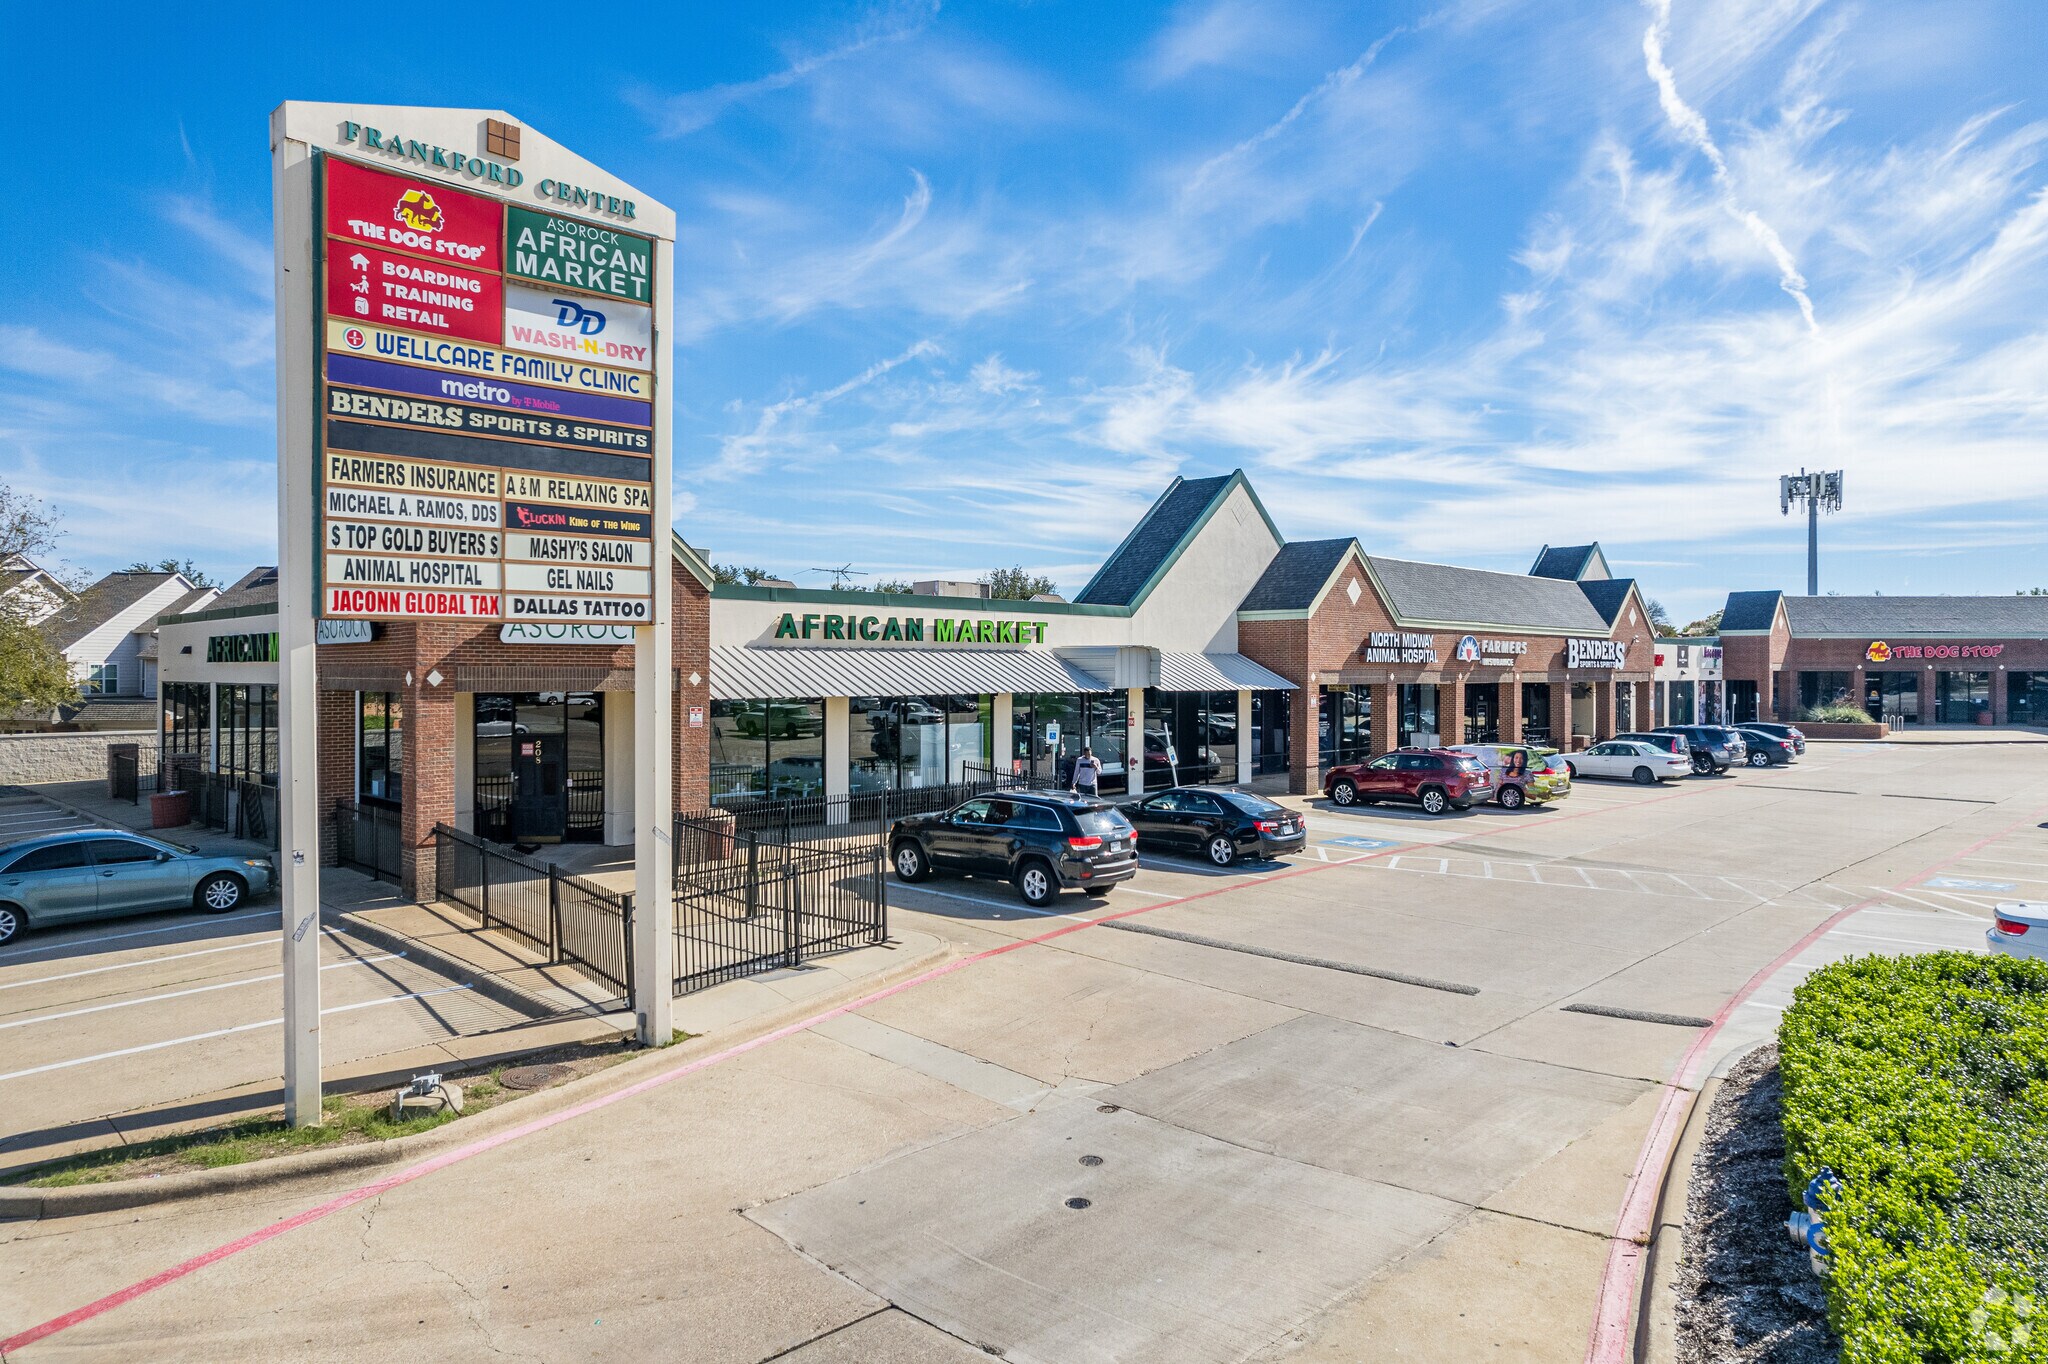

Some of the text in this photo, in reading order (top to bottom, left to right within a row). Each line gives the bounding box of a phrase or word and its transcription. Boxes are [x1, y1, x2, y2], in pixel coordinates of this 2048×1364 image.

[345, 120, 636, 219] FRANKFORD CENTER
[347, 220, 386, 240] THE
[389, 228, 432, 250] DOG
[546, 218, 619, 246] ASOROCK
[516, 227, 646, 276] AFRICAN
[382, 261, 481, 293] BOARDING
[516, 250, 646, 298] MARKET
[382, 282, 474, 312] TRAINING
[382, 304, 449, 328] RETAIL
[552, 298, 607, 335] DD
[512, 325, 647, 361] WASH-N-DRY
[376, 332, 640, 394] WELLCARE FAMILY CLINIC
[441, 379, 511, 403] metro
[512, 395, 522, 407] by
[331, 391, 647, 448] BENDERS SPORTS & SPIRITS
[331, 457, 495, 494] FARMERS INSURANCE
[506, 476, 649, 507] A & M RELAXING SPA
[329, 492, 497, 522] MICHAEL A. RAMOS, DDS
[331, 524, 498, 557] $ TOP GOLD BUYERS $
[530, 538, 633, 562] MASHY'S SALON
[344, 558, 482, 585] ANIMAL HOSPITAL
[547, 568, 614, 591] GEL NAILS
[332, 590, 499, 615] JACONN GLOBAL TAX
[513, 598, 645, 617] DALLAS TATTOO
[318, 620, 367, 639] ASOROCK
[508, 624, 635, 639] ASOROC
[774, 613, 1048, 644] AFRICAN MARKET
[1370, 632, 1434, 648] NORTH MIDWAY
[207, 633, 265, 662] AFRICAN
[1366, 648, 1438, 663] ANIMAL HOSPITAL
[1481, 639, 1528, 654] FARMERS
[1567, 638, 1625, 670] BENDERS
[1893, 645, 1922, 658] THE
[1924, 645, 1959, 658] DOG
[1580, 660, 1596, 668] SPORTS
